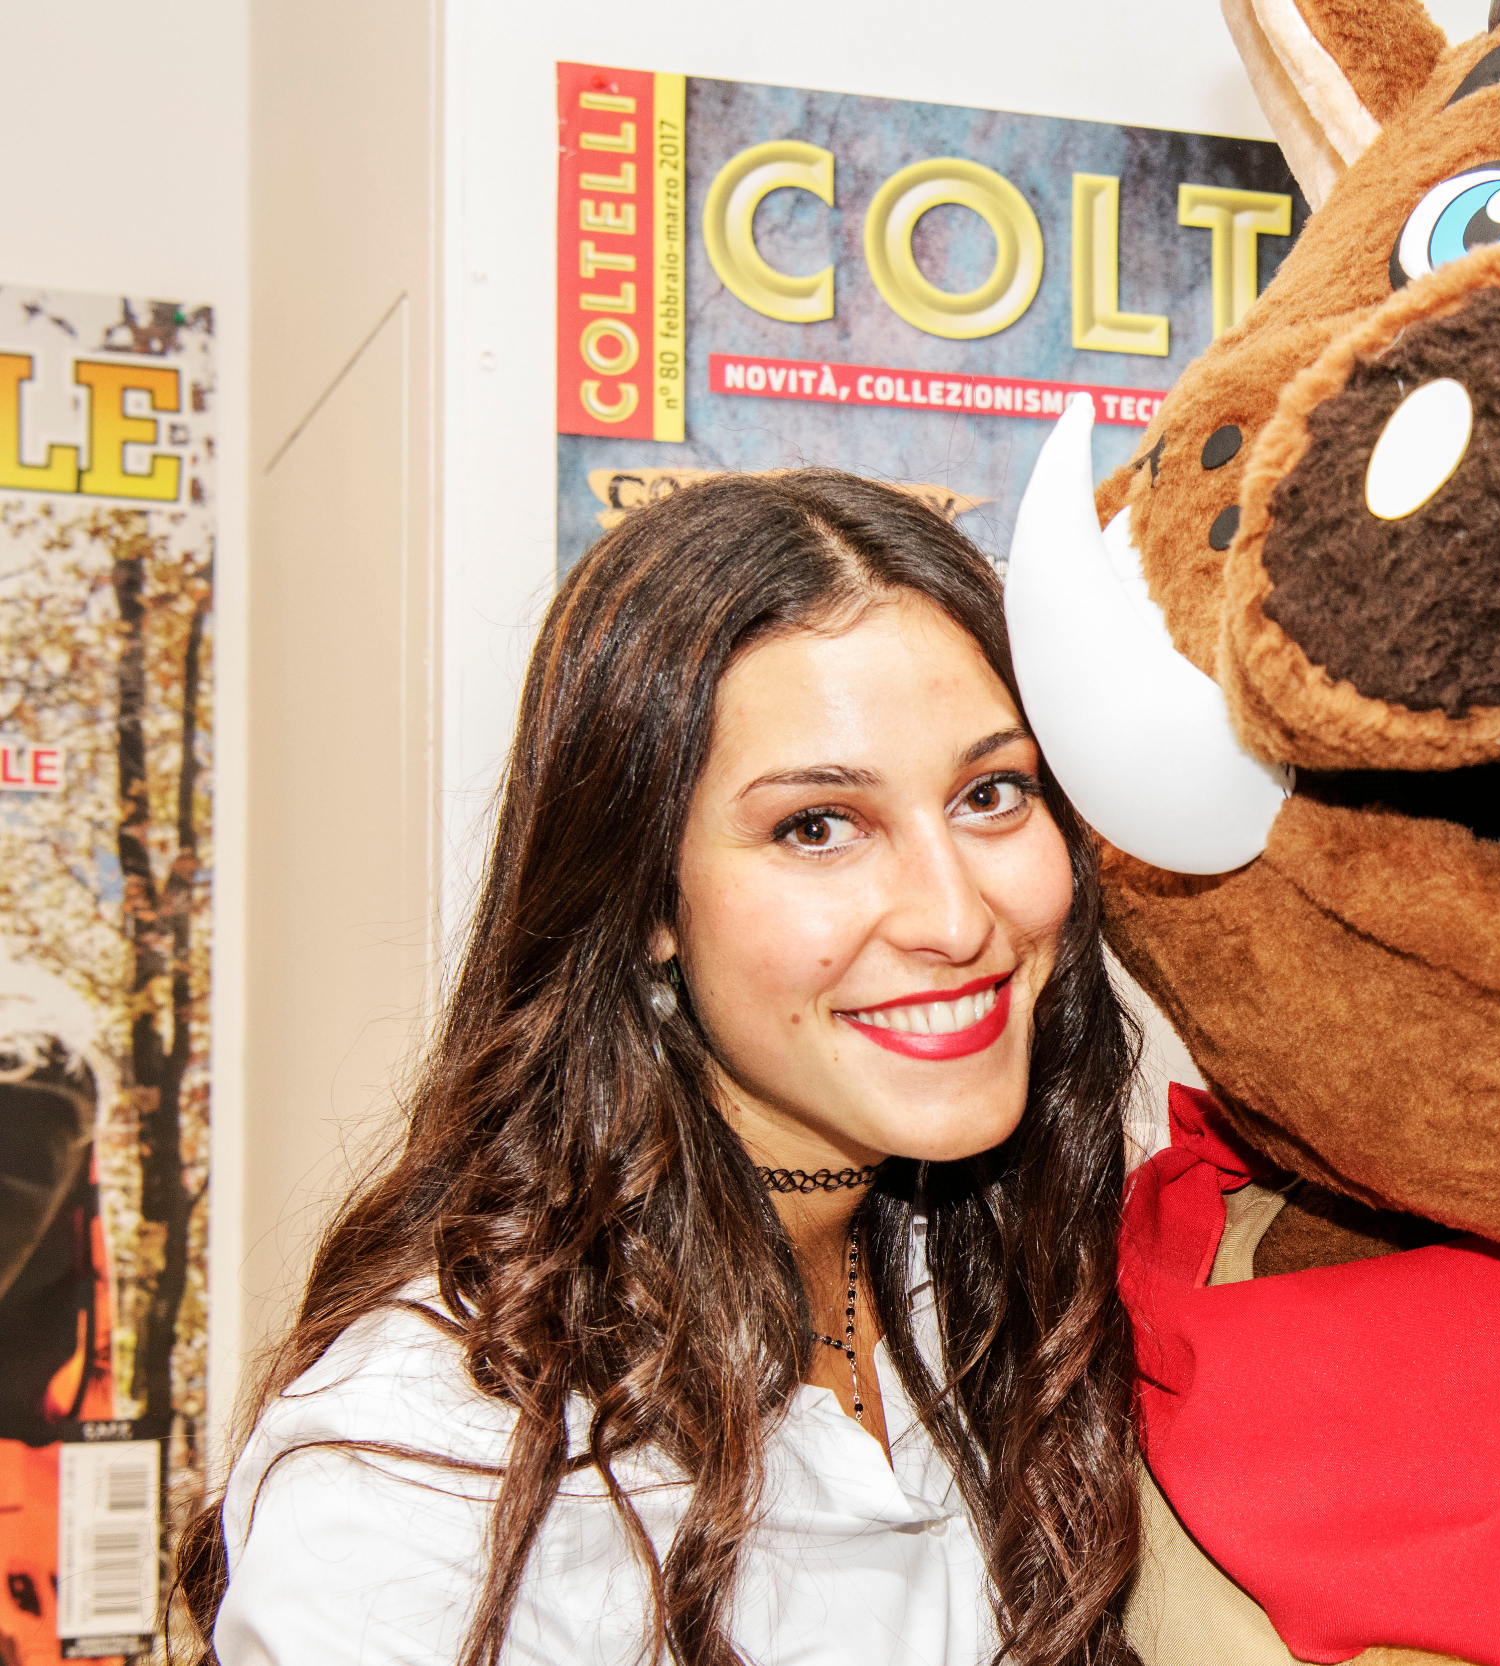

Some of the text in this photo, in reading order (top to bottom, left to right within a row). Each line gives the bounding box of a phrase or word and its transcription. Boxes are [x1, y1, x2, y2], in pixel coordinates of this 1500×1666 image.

[659, 120, 679, 169] 2017
[579, 92, 639, 423] COLTELLI
[660, 177, 680, 342] febbraio-marzo
[702, 139, 1292, 357] COLT
[660, 350, 679, 381] 80
[724, 363, 851, 401] NOVITÀ,
[1, 748, 59, 787] LE
